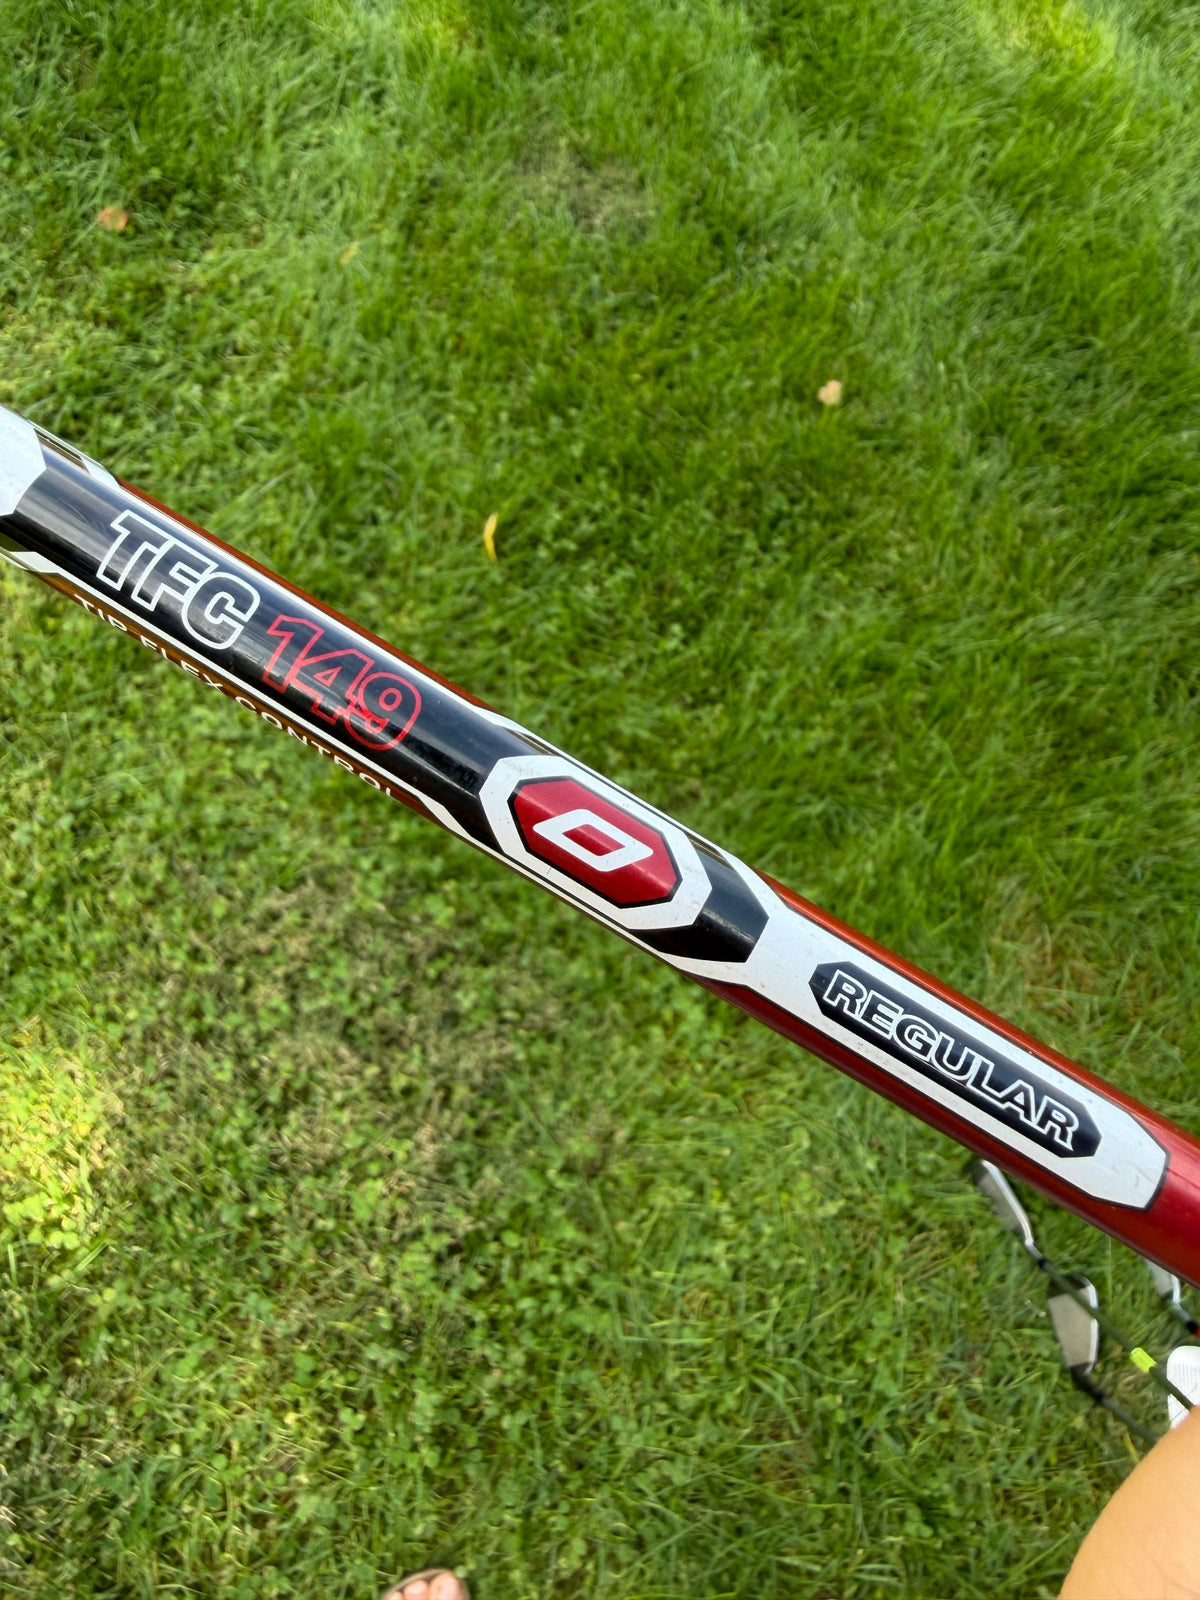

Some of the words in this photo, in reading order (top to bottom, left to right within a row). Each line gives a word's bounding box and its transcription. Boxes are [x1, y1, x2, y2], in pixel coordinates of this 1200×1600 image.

[74, 594, 128, 632] TIP
[141, 635, 223, 691] FLEX
[236, 696, 396, 800] CONTROL
[97, 510, 260, 649] TFC
[263, 615, 422, 750] 149
[823, 969, 1079, 1152] REGULAR
